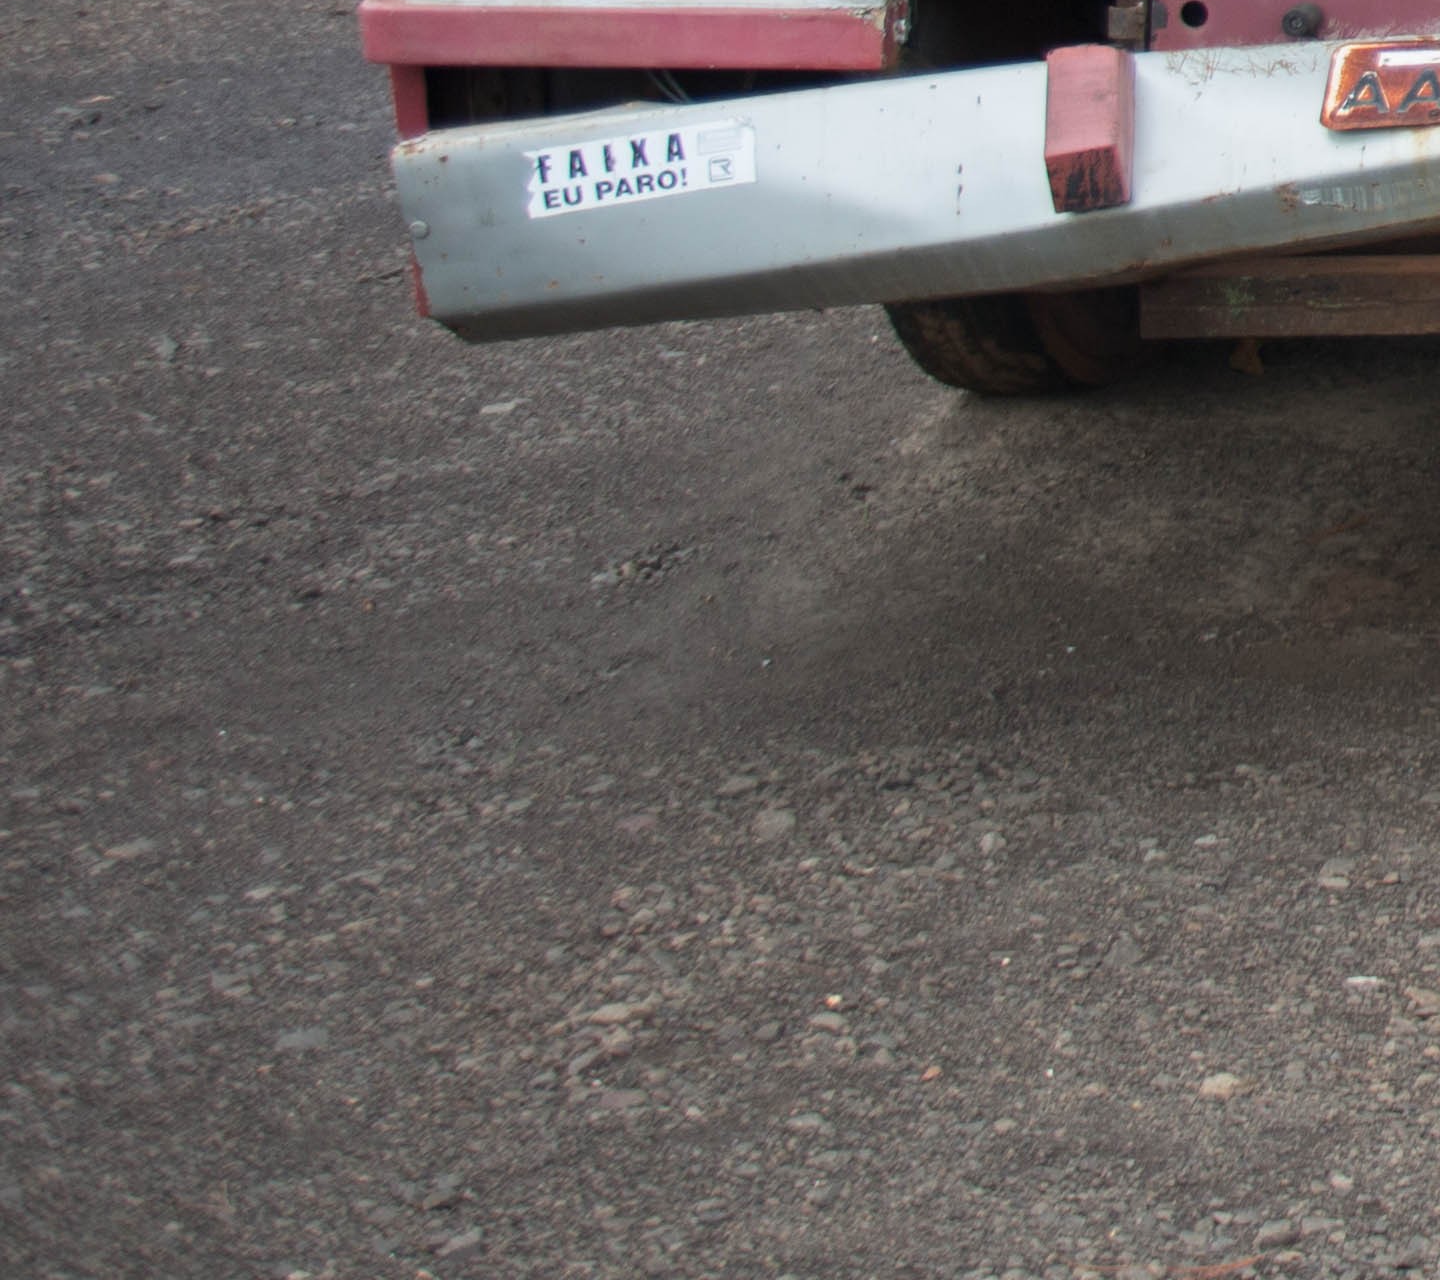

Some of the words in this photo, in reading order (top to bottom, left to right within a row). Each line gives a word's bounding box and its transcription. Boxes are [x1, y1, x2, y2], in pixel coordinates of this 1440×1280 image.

[535, 132, 688, 184] FAIXA
[543, 185, 583, 210] EU
[595, 167, 689, 201] PARO!
